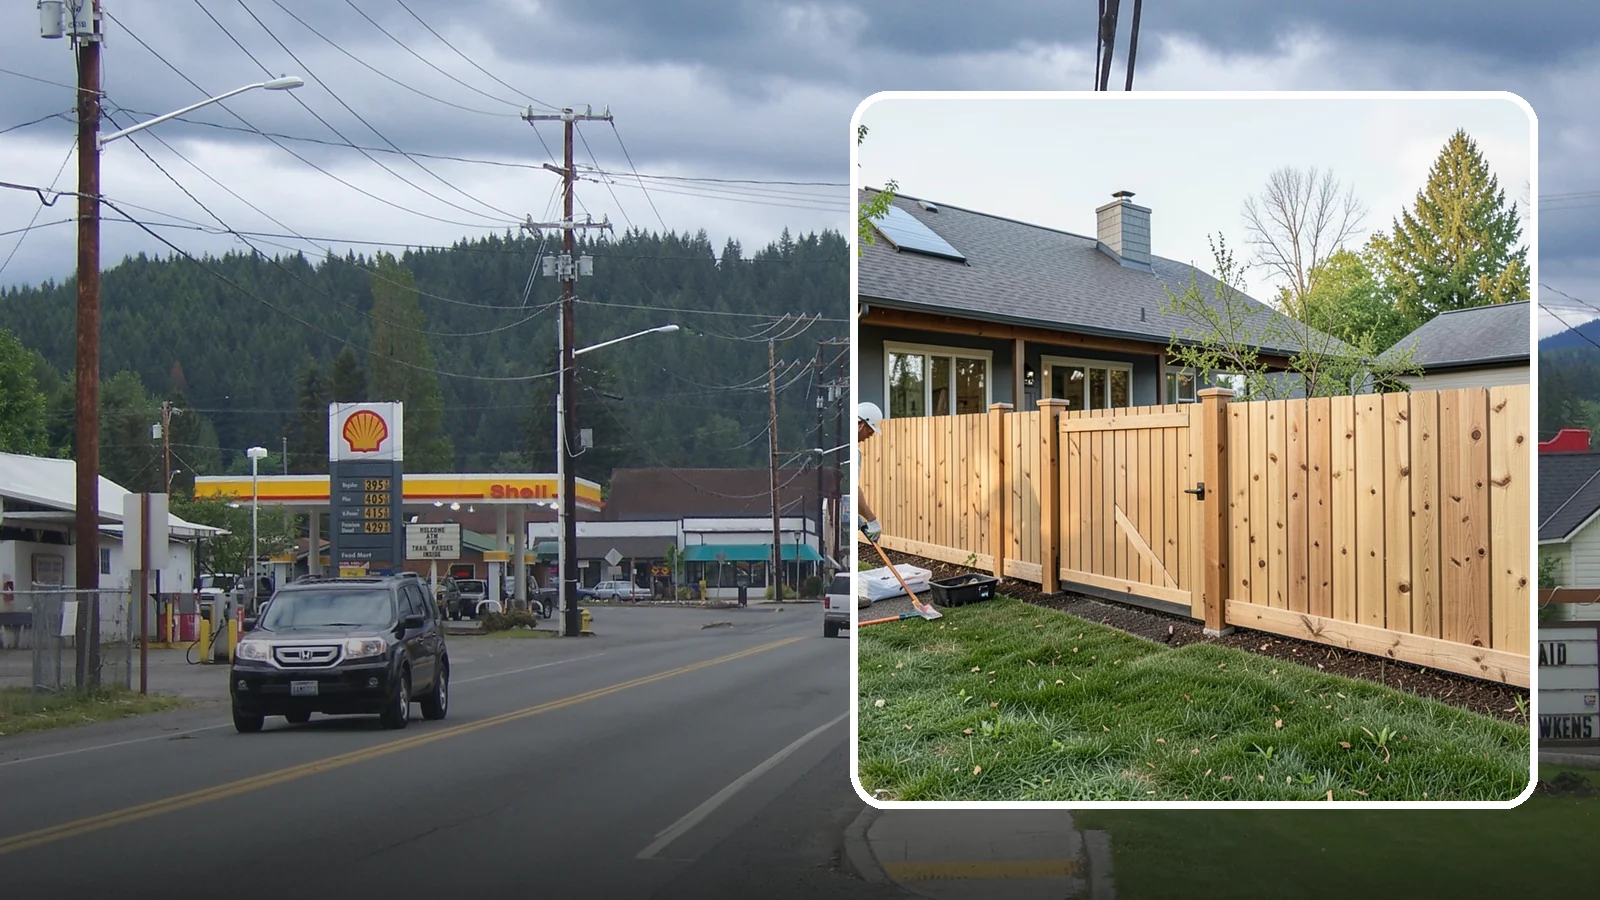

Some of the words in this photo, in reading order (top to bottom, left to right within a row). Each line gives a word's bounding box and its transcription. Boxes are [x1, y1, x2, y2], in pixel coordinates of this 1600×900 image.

[366, 480, 383, 490] 395
[490, 484, 547, 499] Shell
[365, 494, 383, 504] 405
[365, 508, 383, 518] 415
[365, 522, 383, 532] 429
